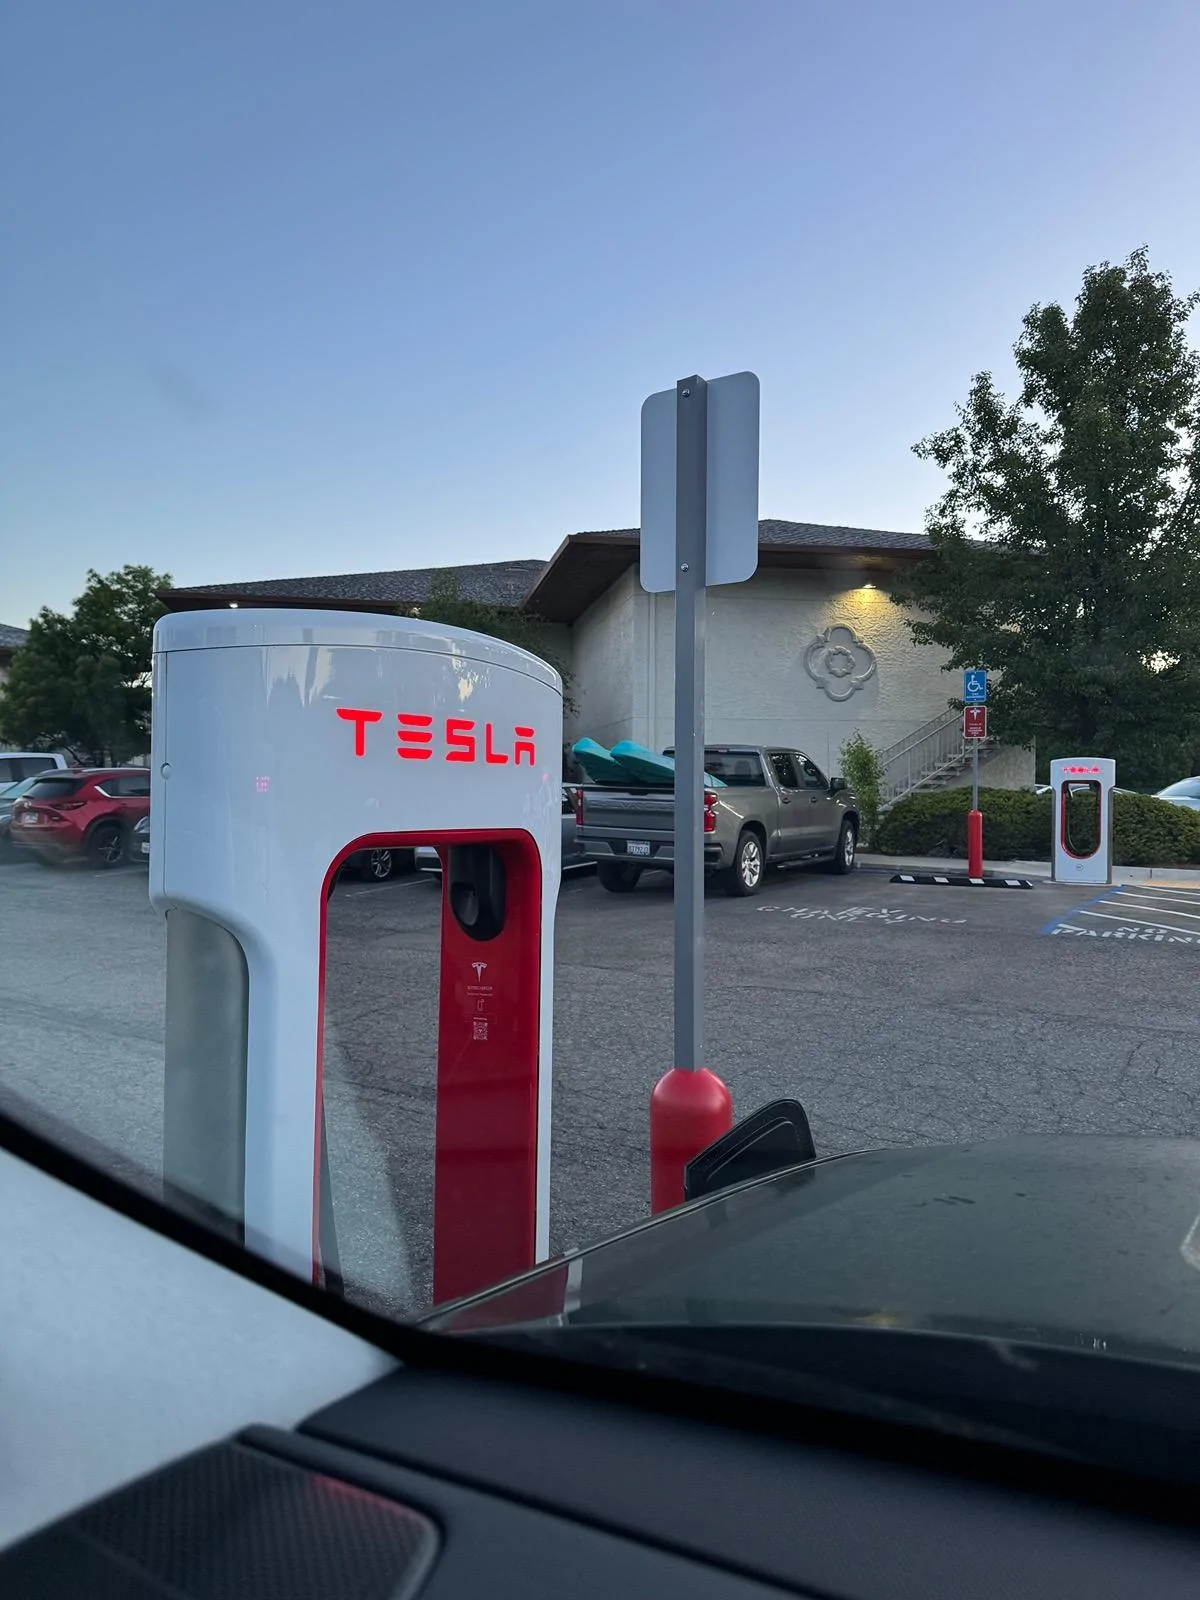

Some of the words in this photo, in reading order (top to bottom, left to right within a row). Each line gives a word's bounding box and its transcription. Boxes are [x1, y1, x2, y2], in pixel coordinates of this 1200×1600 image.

[336, 708, 535, 766] TESLA
[1051, 928, 1200, 944] PARKIN
[1117, 926, 1168, 934] NO
